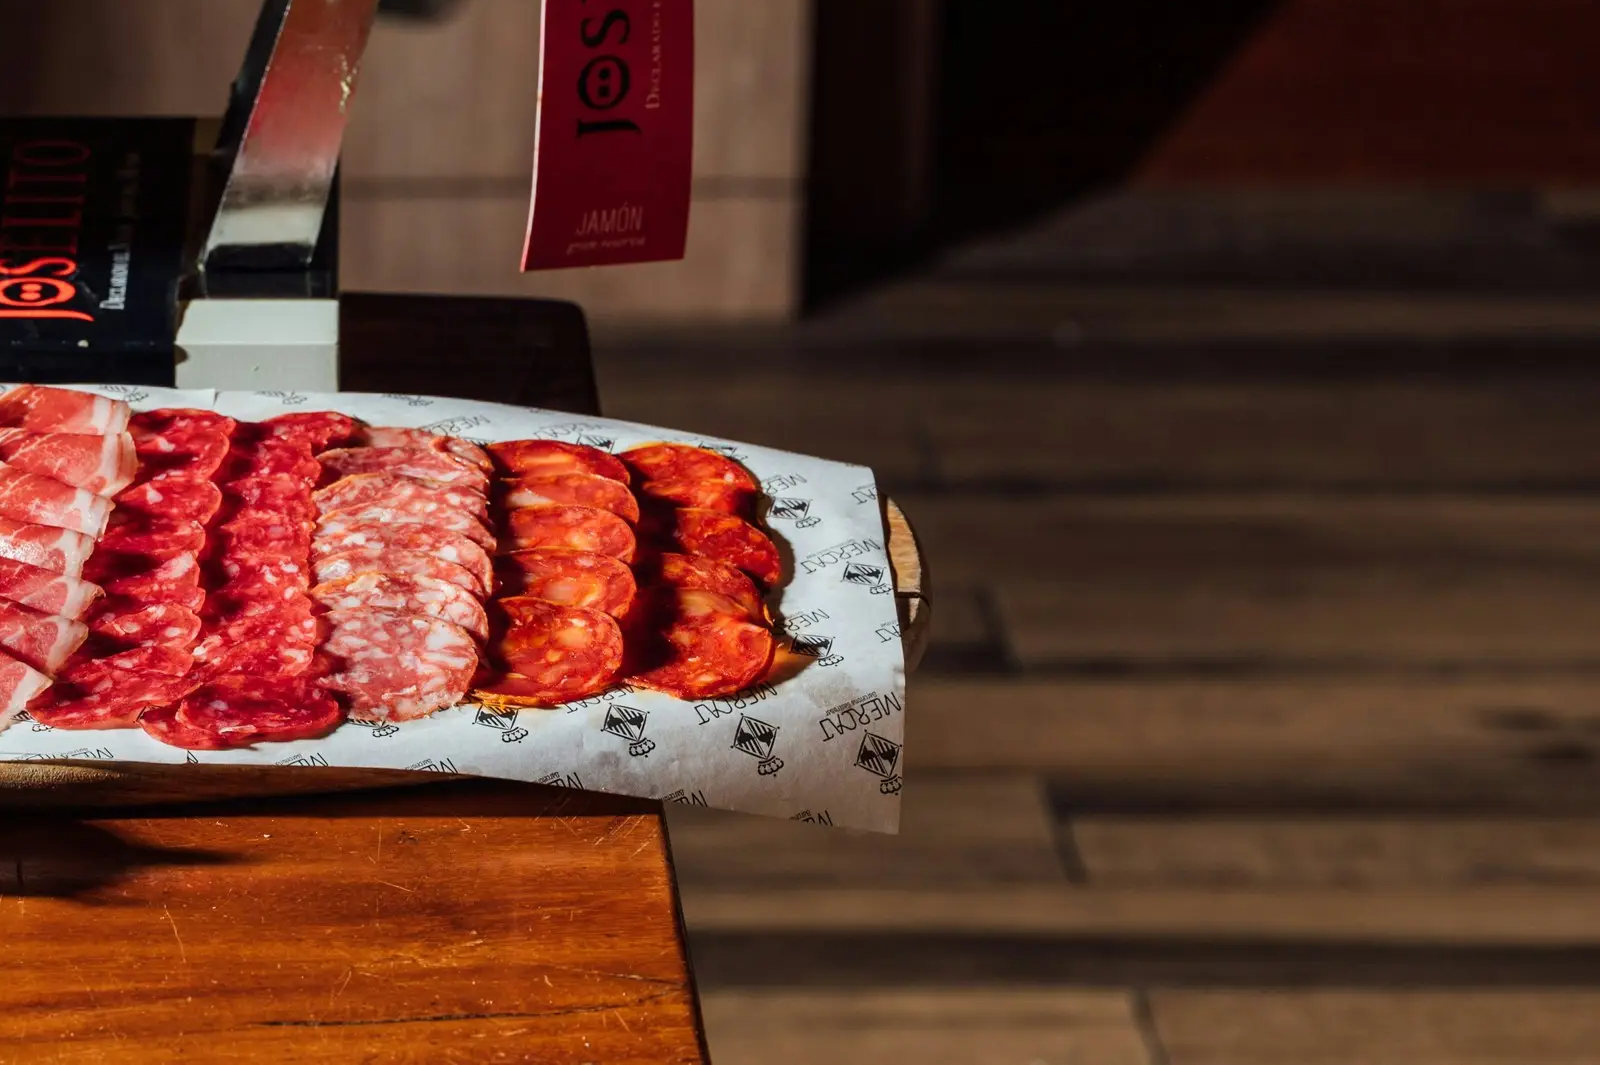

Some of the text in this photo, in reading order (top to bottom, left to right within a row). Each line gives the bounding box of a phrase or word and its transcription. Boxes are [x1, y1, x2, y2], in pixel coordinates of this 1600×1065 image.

[574, 199, 644, 236] JAMÓN
[800, 539, 881, 575] MERCAT
[694, 680, 778, 726] MERCAT
[819, 691, 902, 742] MERCAT
